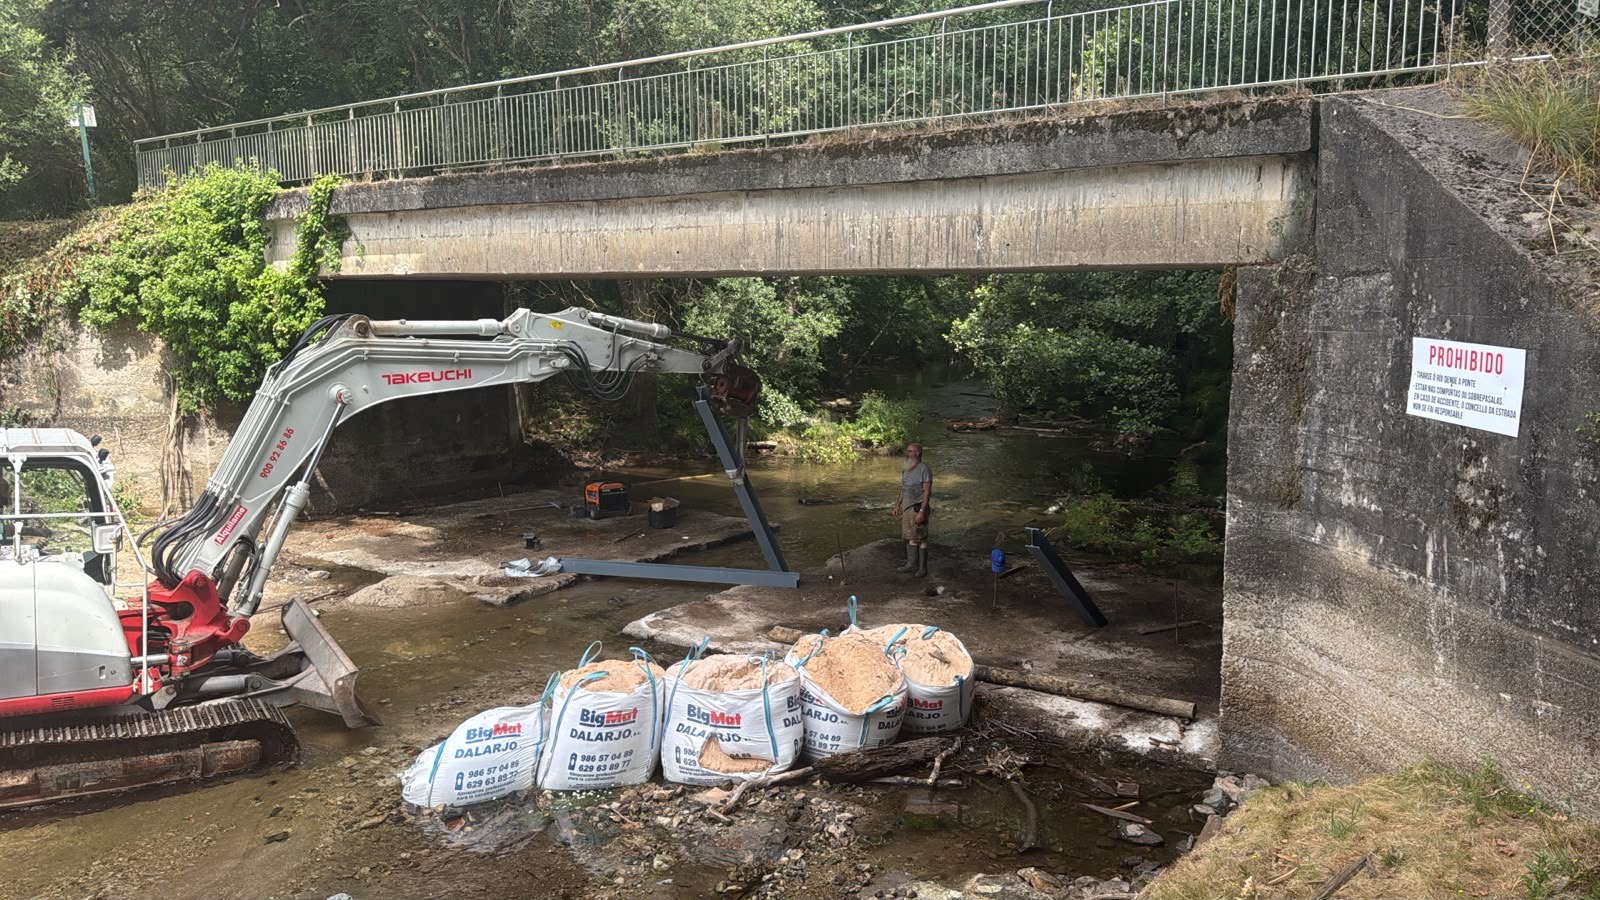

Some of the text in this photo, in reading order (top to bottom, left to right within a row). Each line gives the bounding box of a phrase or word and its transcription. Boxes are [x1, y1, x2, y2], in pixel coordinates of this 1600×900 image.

[1430, 345, 1503, 375] PROHIBIDO
[382, 368, 472, 385] TAKEUCHI
[1462, 378, 1476, 388] PONTE
[1415, 382, 1427, 391] ESTAR
[1420, 394, 1430, 402] CASO
[1465, 402, 1487, 413] CONCELLO
[1496, 408, 1516, 418] ESTRADA
[1435, 406, 1463, 419] RESPONSABLE
[260, 428, 294, 478] 900 92 86 86
[580, 707, 638, 727] BigMat
[688, 704, 742, 725] BigMat
[466, 723, 522, 740] BigMat
[468, 760, 520, 778] 986 57 04 89
[622, 759, 631, 768] 77
[466, 780, 483, 789] 629
[485, 777, 495, 785] 63
